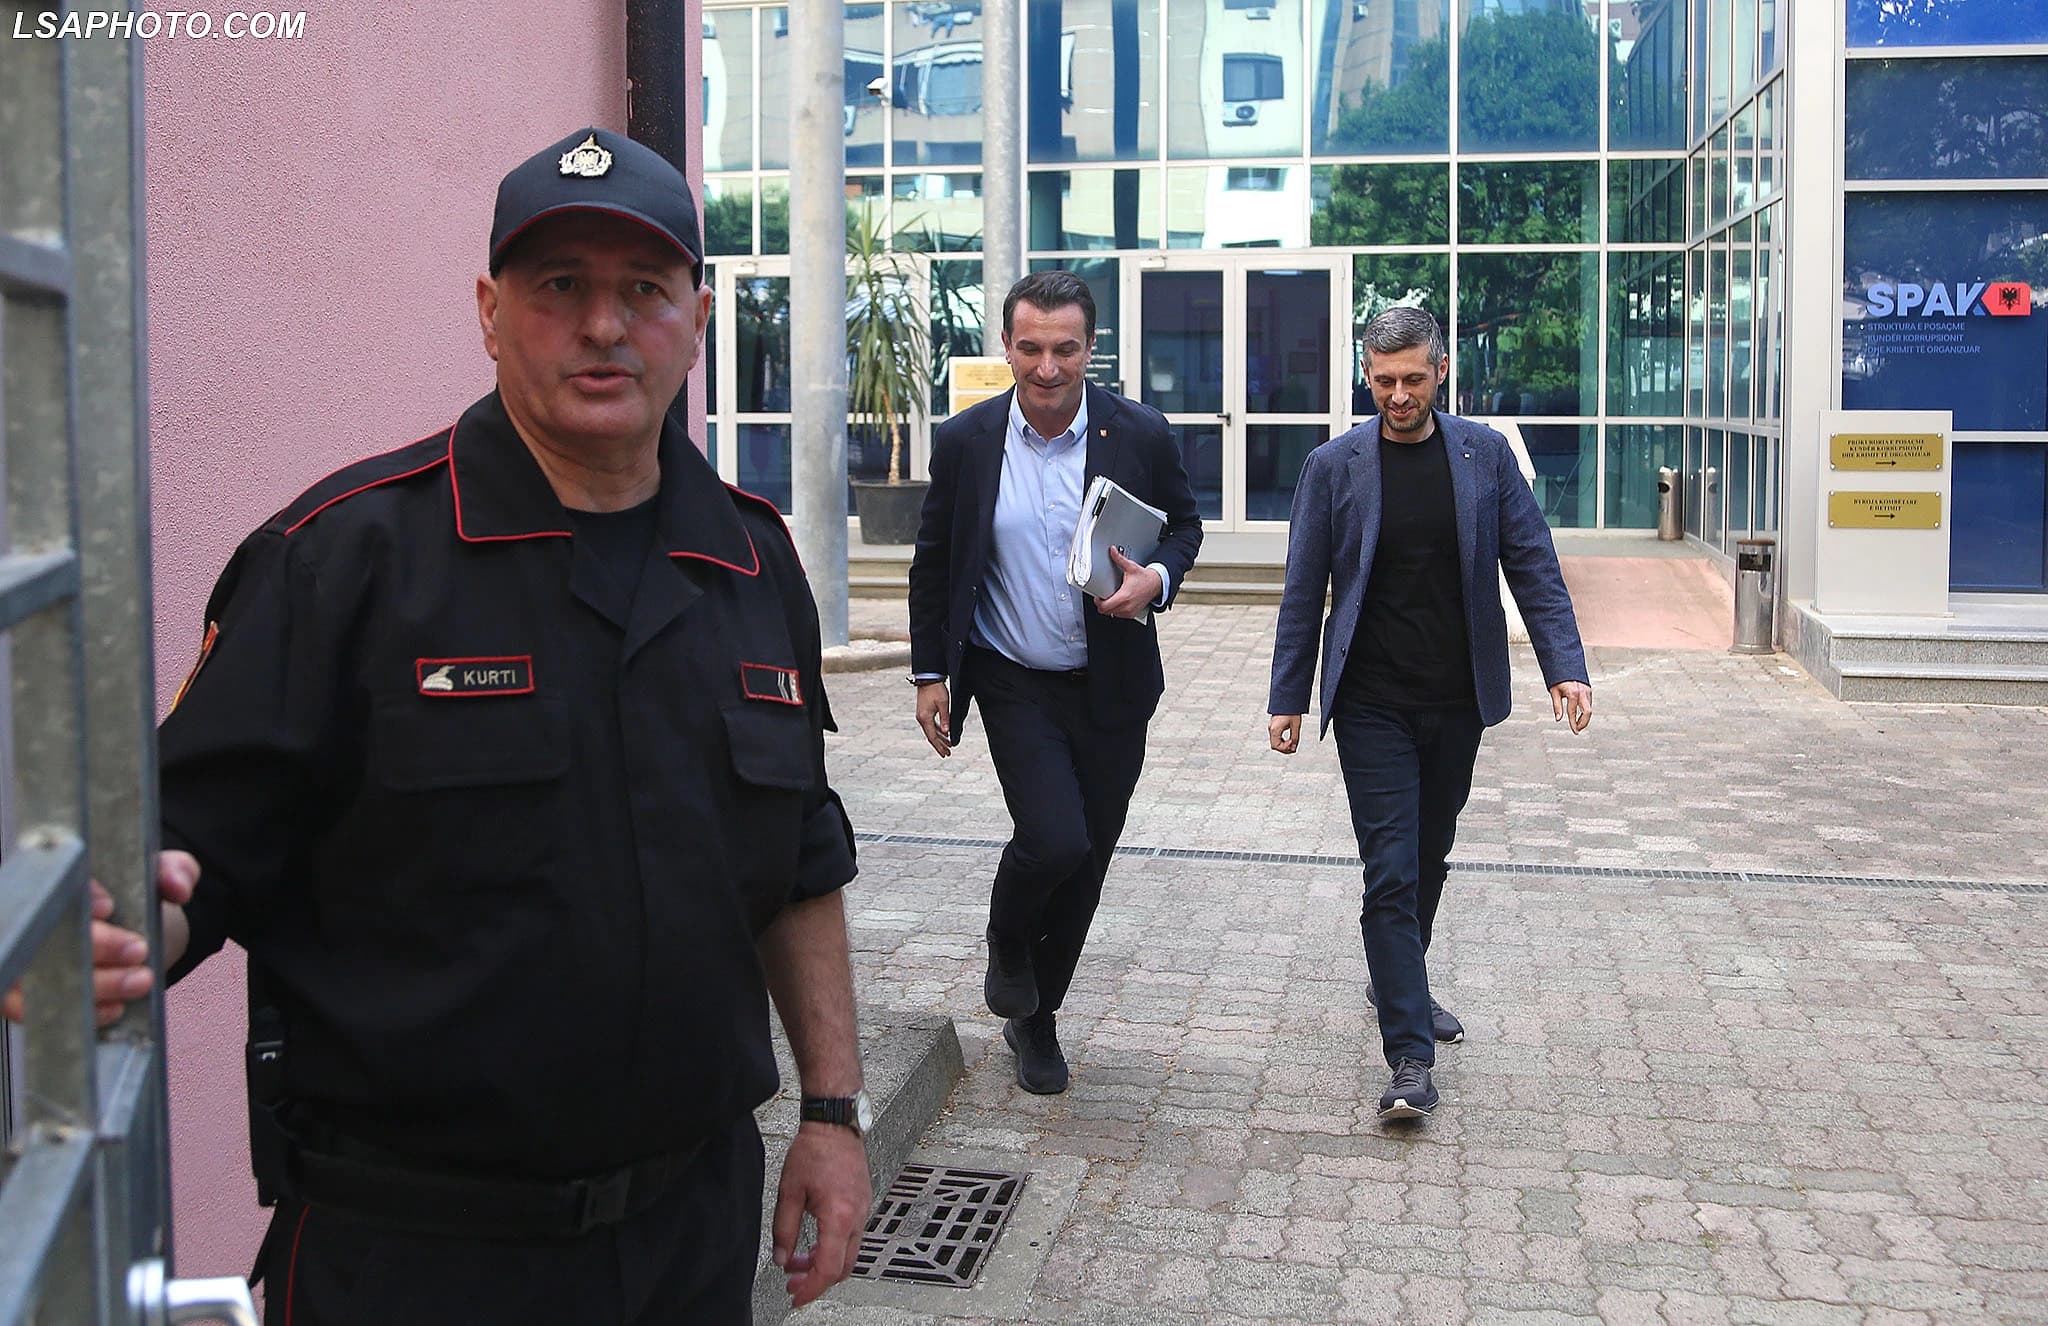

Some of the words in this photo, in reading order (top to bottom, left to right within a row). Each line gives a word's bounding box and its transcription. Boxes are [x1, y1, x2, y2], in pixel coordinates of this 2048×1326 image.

[1866, 282, 1986, 317] SPAK
[1867, 322, 1917, 331] STRUKTURA
[1918, 322, 1923, 331] E
[1903, 333, 1964, 342] KORRUPSIONIT
[1926, 345, 1981, 354] ORGANIZUAR
[463, 669, 516, 686] KURTI
